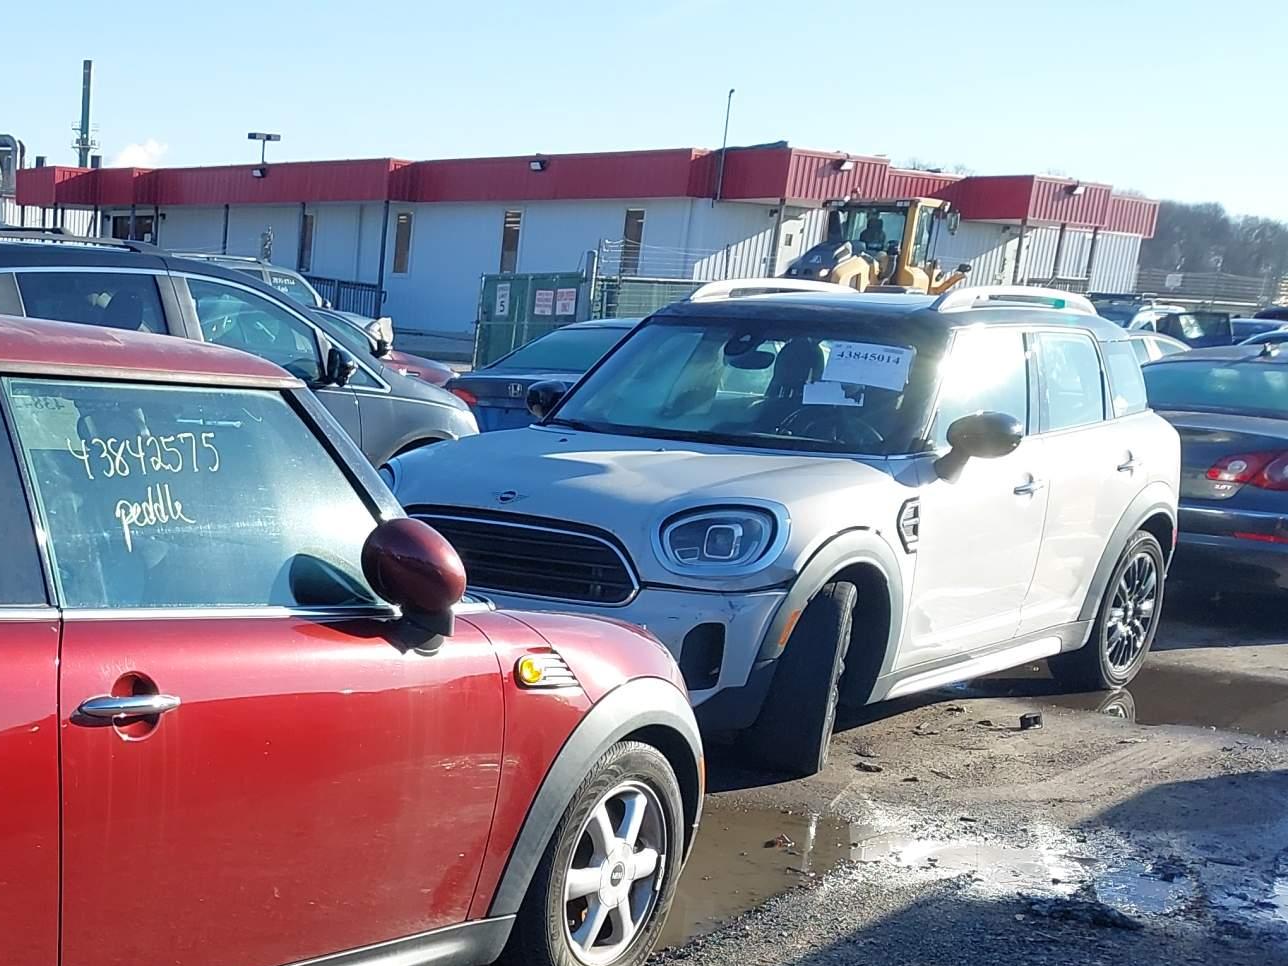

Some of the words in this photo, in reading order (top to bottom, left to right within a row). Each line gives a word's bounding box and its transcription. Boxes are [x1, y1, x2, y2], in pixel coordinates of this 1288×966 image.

[499, 300, 505, 312] 5
[836, 350, 901, 365] 43845014
[66, 432, 220, 480] 43842575
[115, 483, 196, 552] peddle
